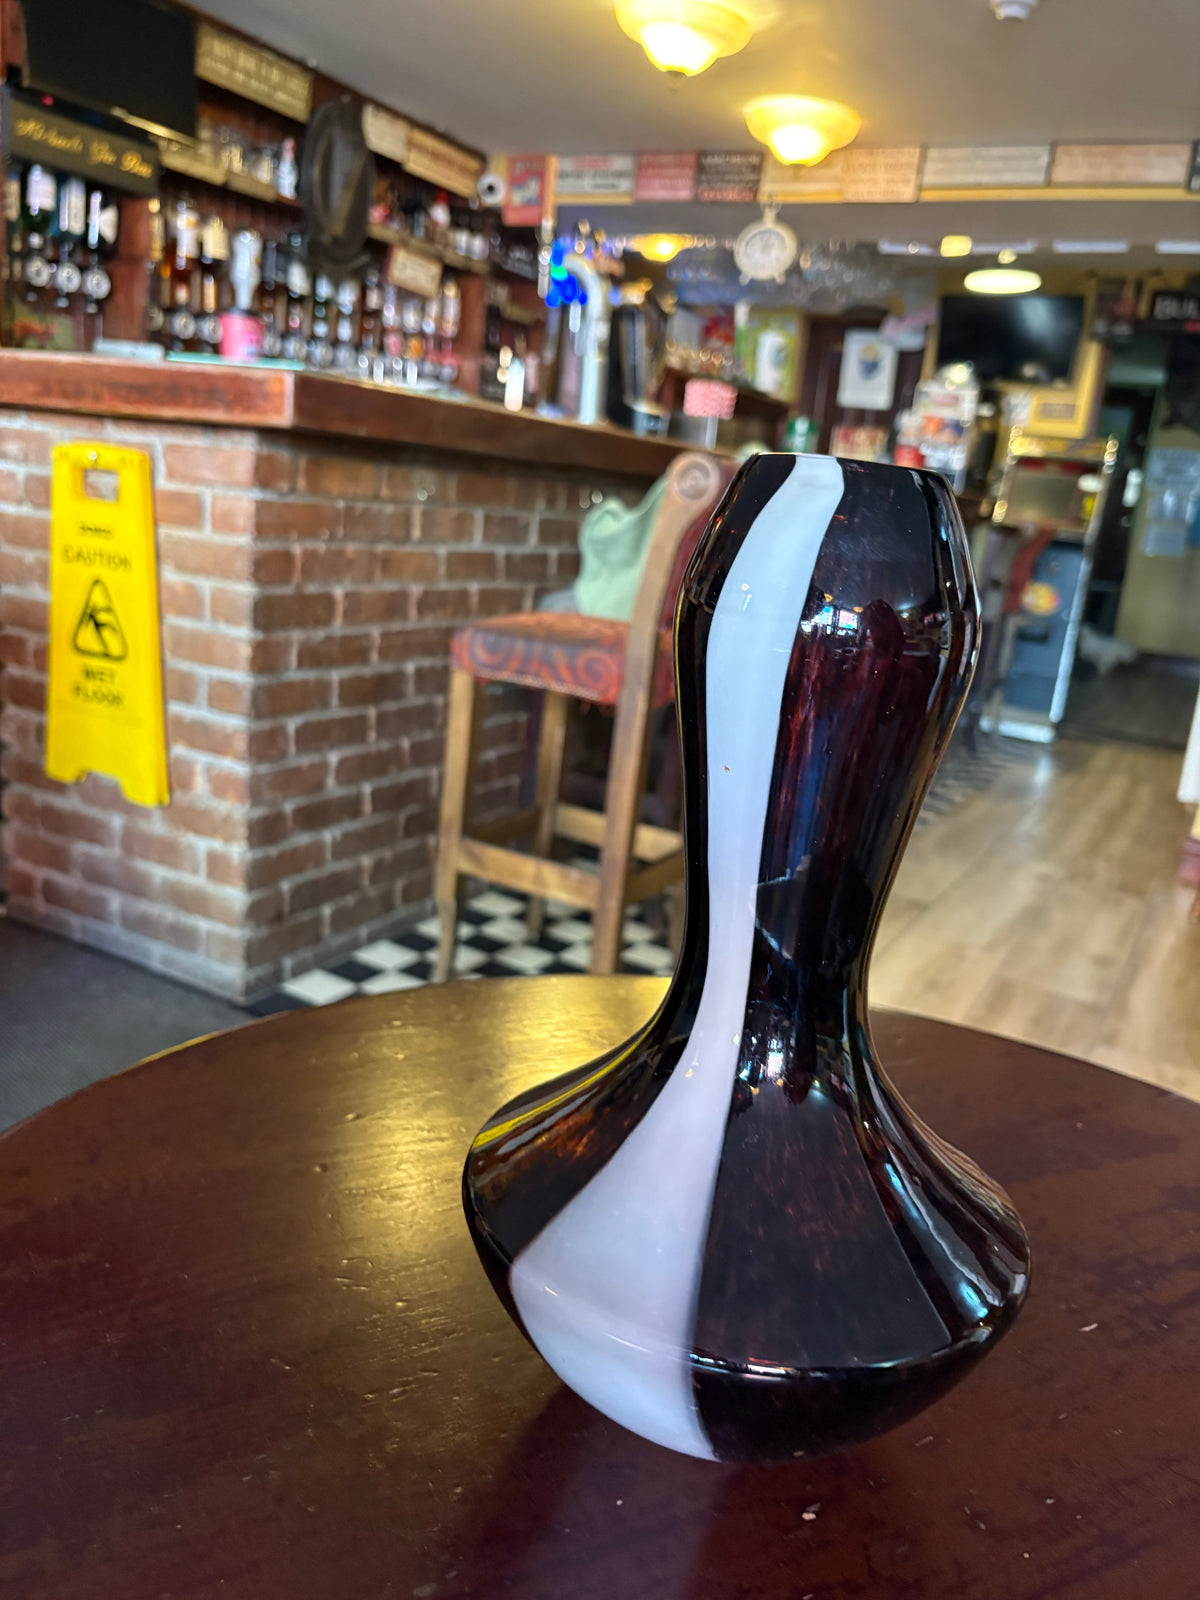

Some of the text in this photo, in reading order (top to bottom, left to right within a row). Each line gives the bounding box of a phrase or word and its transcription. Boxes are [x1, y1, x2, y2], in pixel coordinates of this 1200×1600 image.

[63, 545, 132, 572] CAUTION
[83, 665, 115, 685] WET
[72, 682, 124, 707] FLOOR
